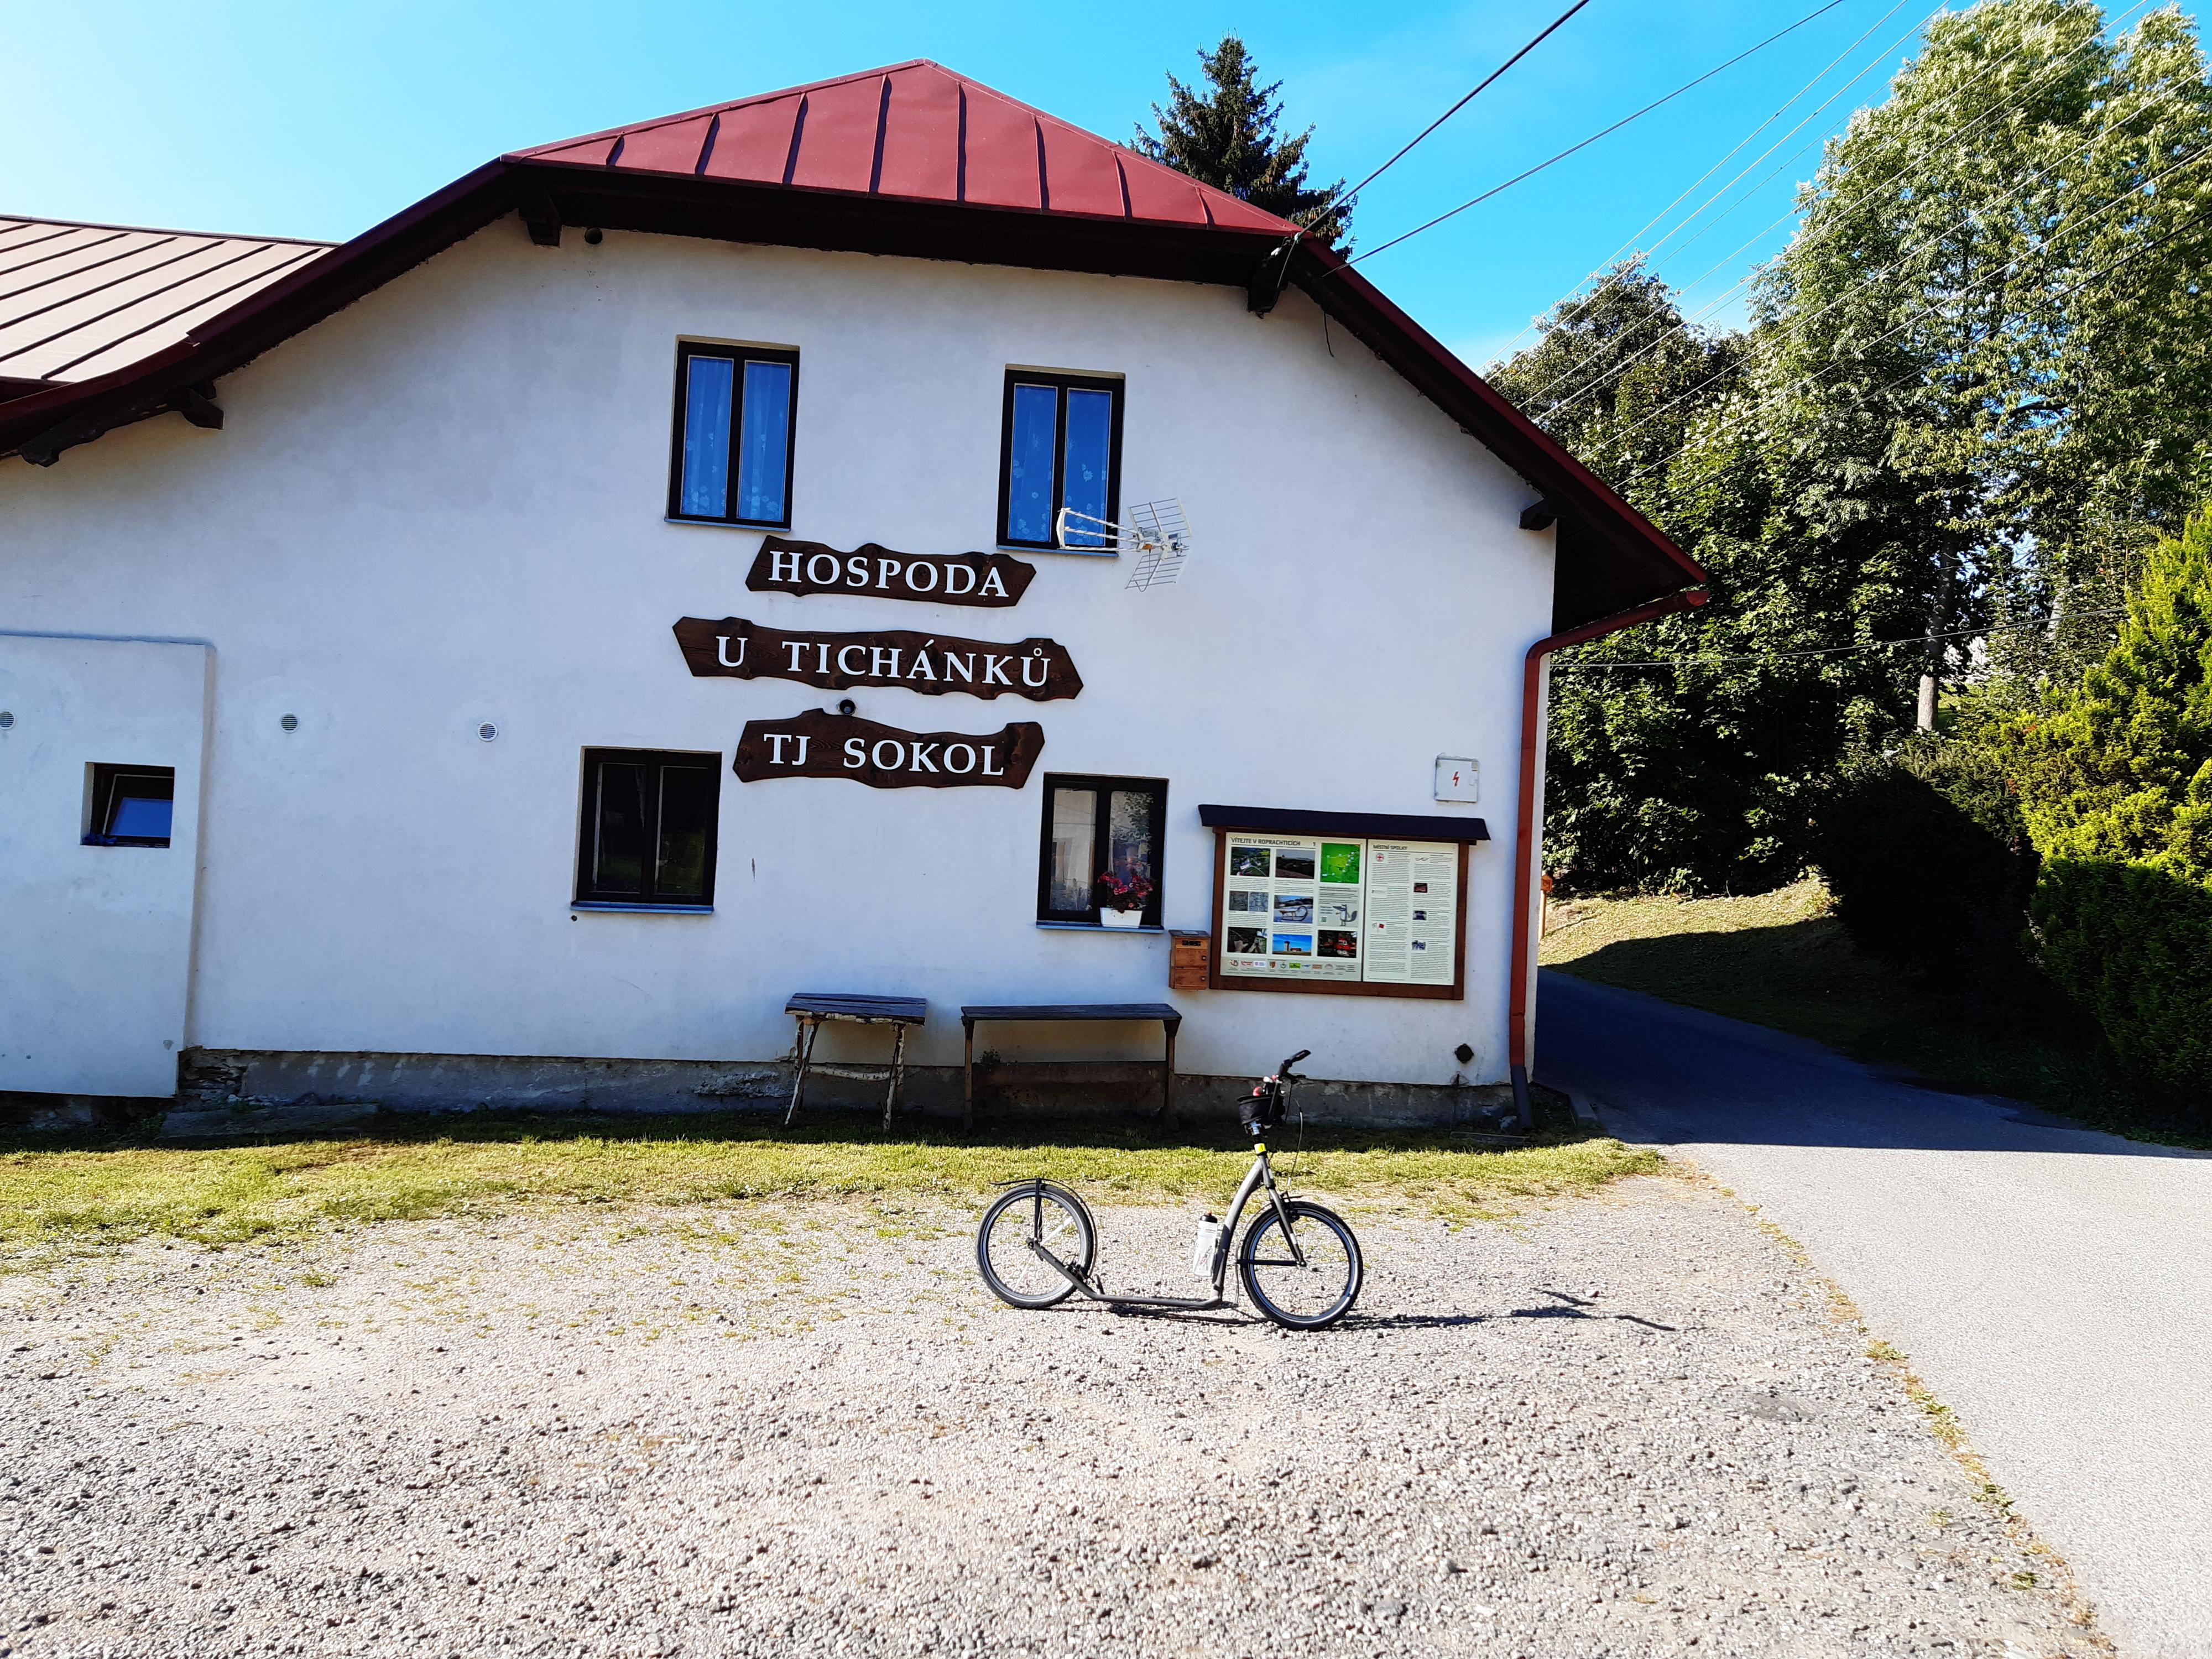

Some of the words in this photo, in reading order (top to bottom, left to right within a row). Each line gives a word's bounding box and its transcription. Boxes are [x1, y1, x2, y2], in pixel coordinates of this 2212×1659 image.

[768, 551, 1009, 597] HOSPODA
[716, 636, 748, 667] U
[782, 639, 1051, 687] TICHÁNKŮ
[764, 734, 811, 765] TJ
[843, 738, 1004, 776] SOKOL
